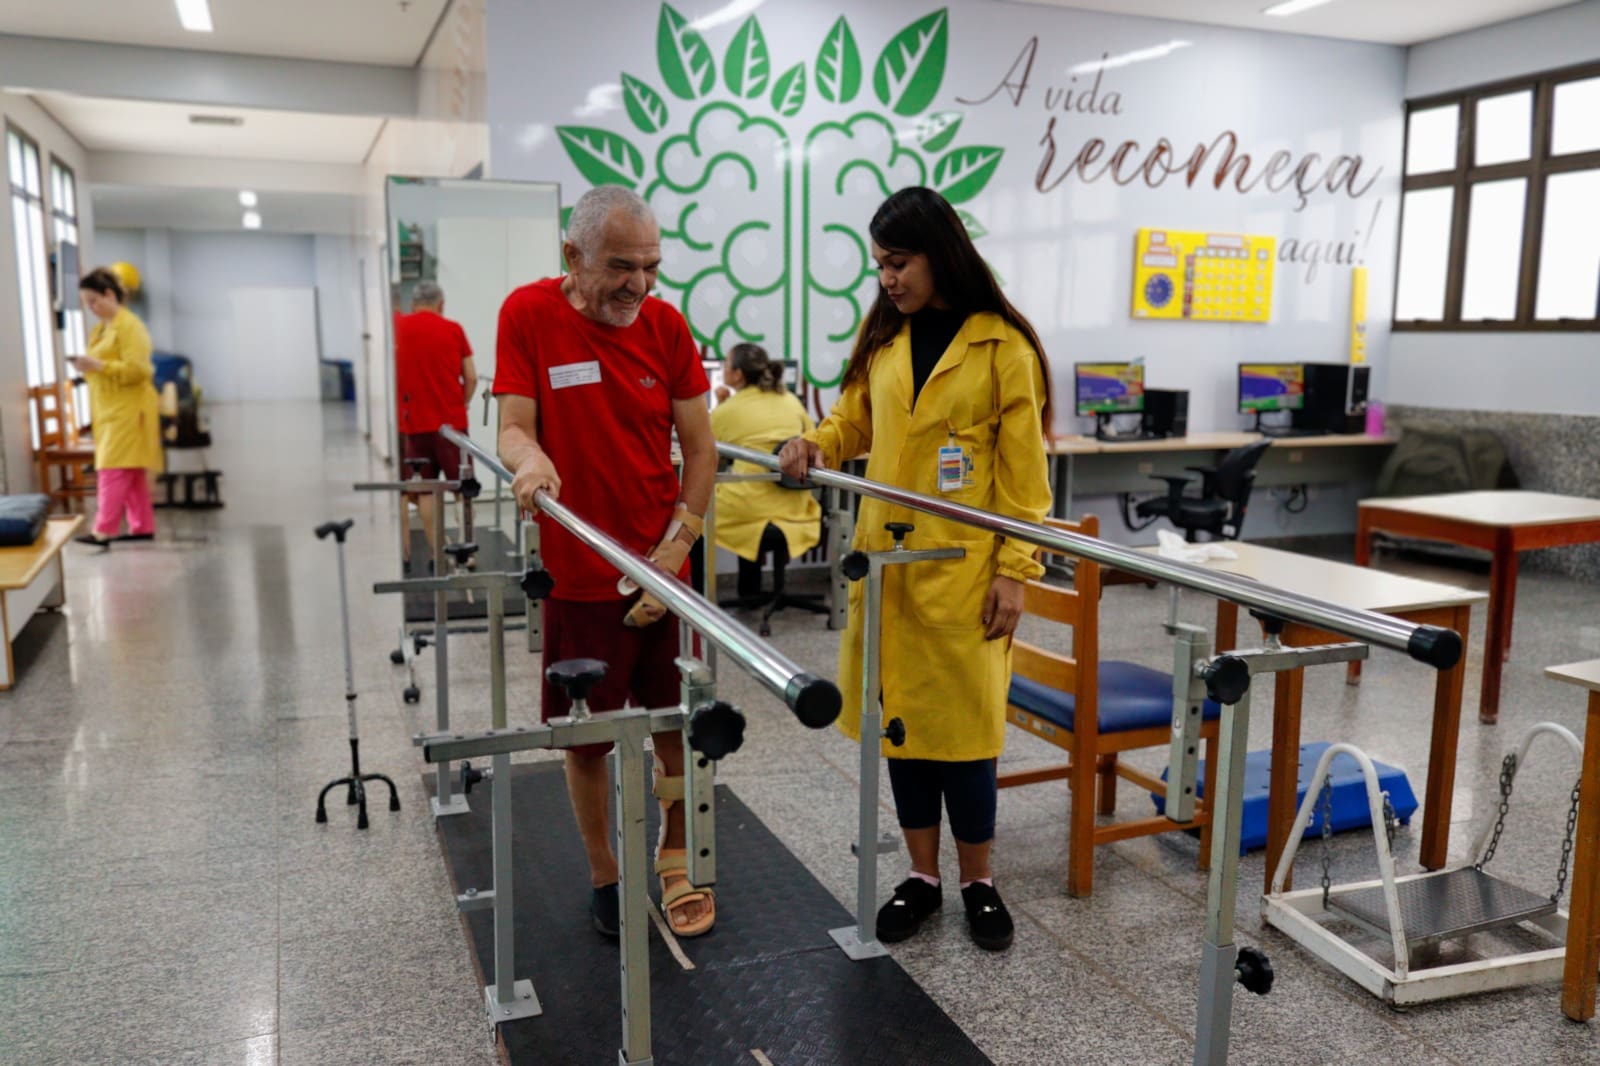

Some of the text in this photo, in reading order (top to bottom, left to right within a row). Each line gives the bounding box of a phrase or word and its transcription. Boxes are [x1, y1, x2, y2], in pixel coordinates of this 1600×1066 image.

[954, 35, 1122, 115] A vida
[1035, 117, 1383, 212] recomeça
[1277, 198, 1382, 285] aqui!
